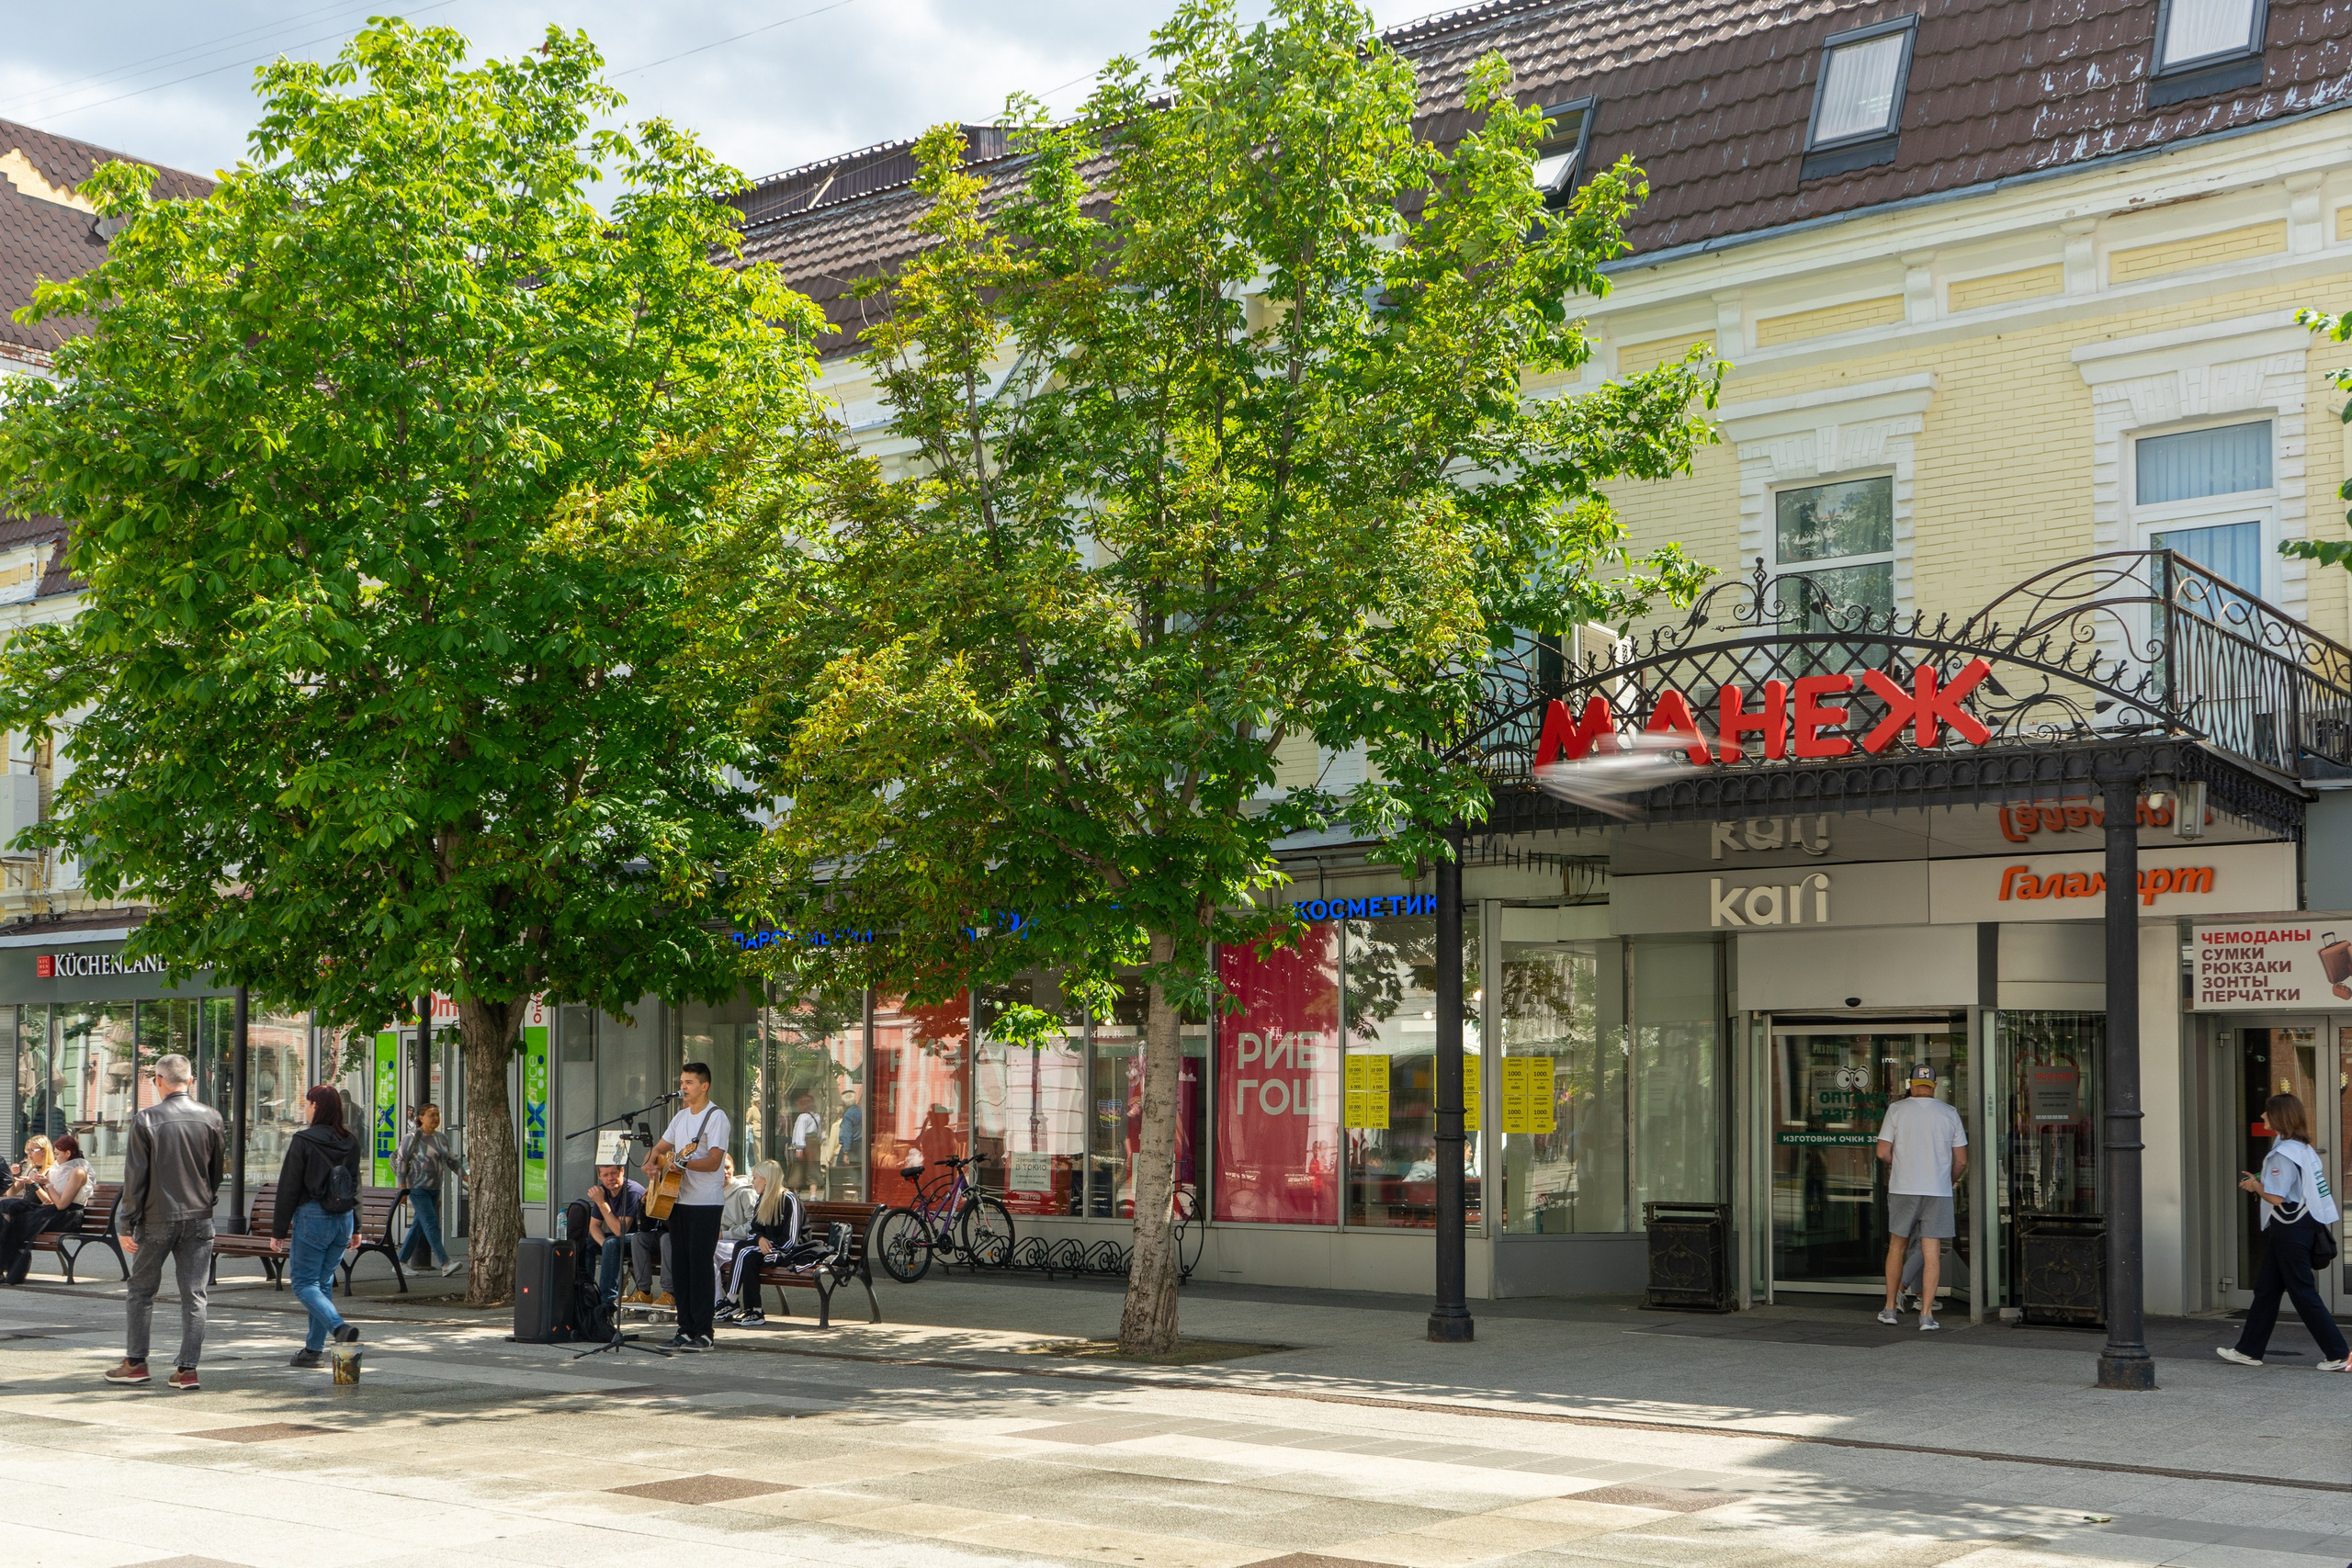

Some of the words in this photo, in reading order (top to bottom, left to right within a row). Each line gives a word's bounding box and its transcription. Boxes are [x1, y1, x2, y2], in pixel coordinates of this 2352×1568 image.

[1532, 658, 1992, 777] МАНЕЖ
[1998, 865, 2214, 906] Галамрт
[1294, 894, 1437, 920] КОСМЕТИК
[1711, 872, 1829, 927] kari
[2201, 930, 2311, 945] ЧЕМОДАНЫ
[2201, 947, 2265, 961] СУМКИ
[2201, 961, 2291, 975] РЮКЗАКИ
[2202, 976, 2268, 988] ЗОНТЫ
[2202, 988, 2301, 1003] ПЕРЧАТКИ
[1238, 1031, 1326, 1069] РИВ
[1237, 1078, 1326, 1115] ГОШ
[1819, 1090, 1889, 1104] ОПТИКА
[1822, 1108, 1885, 1122] ВЗГЛЯД
[378, 1103, 395, 1158] FIX
[526, 1100, 546, 1159] FIX
